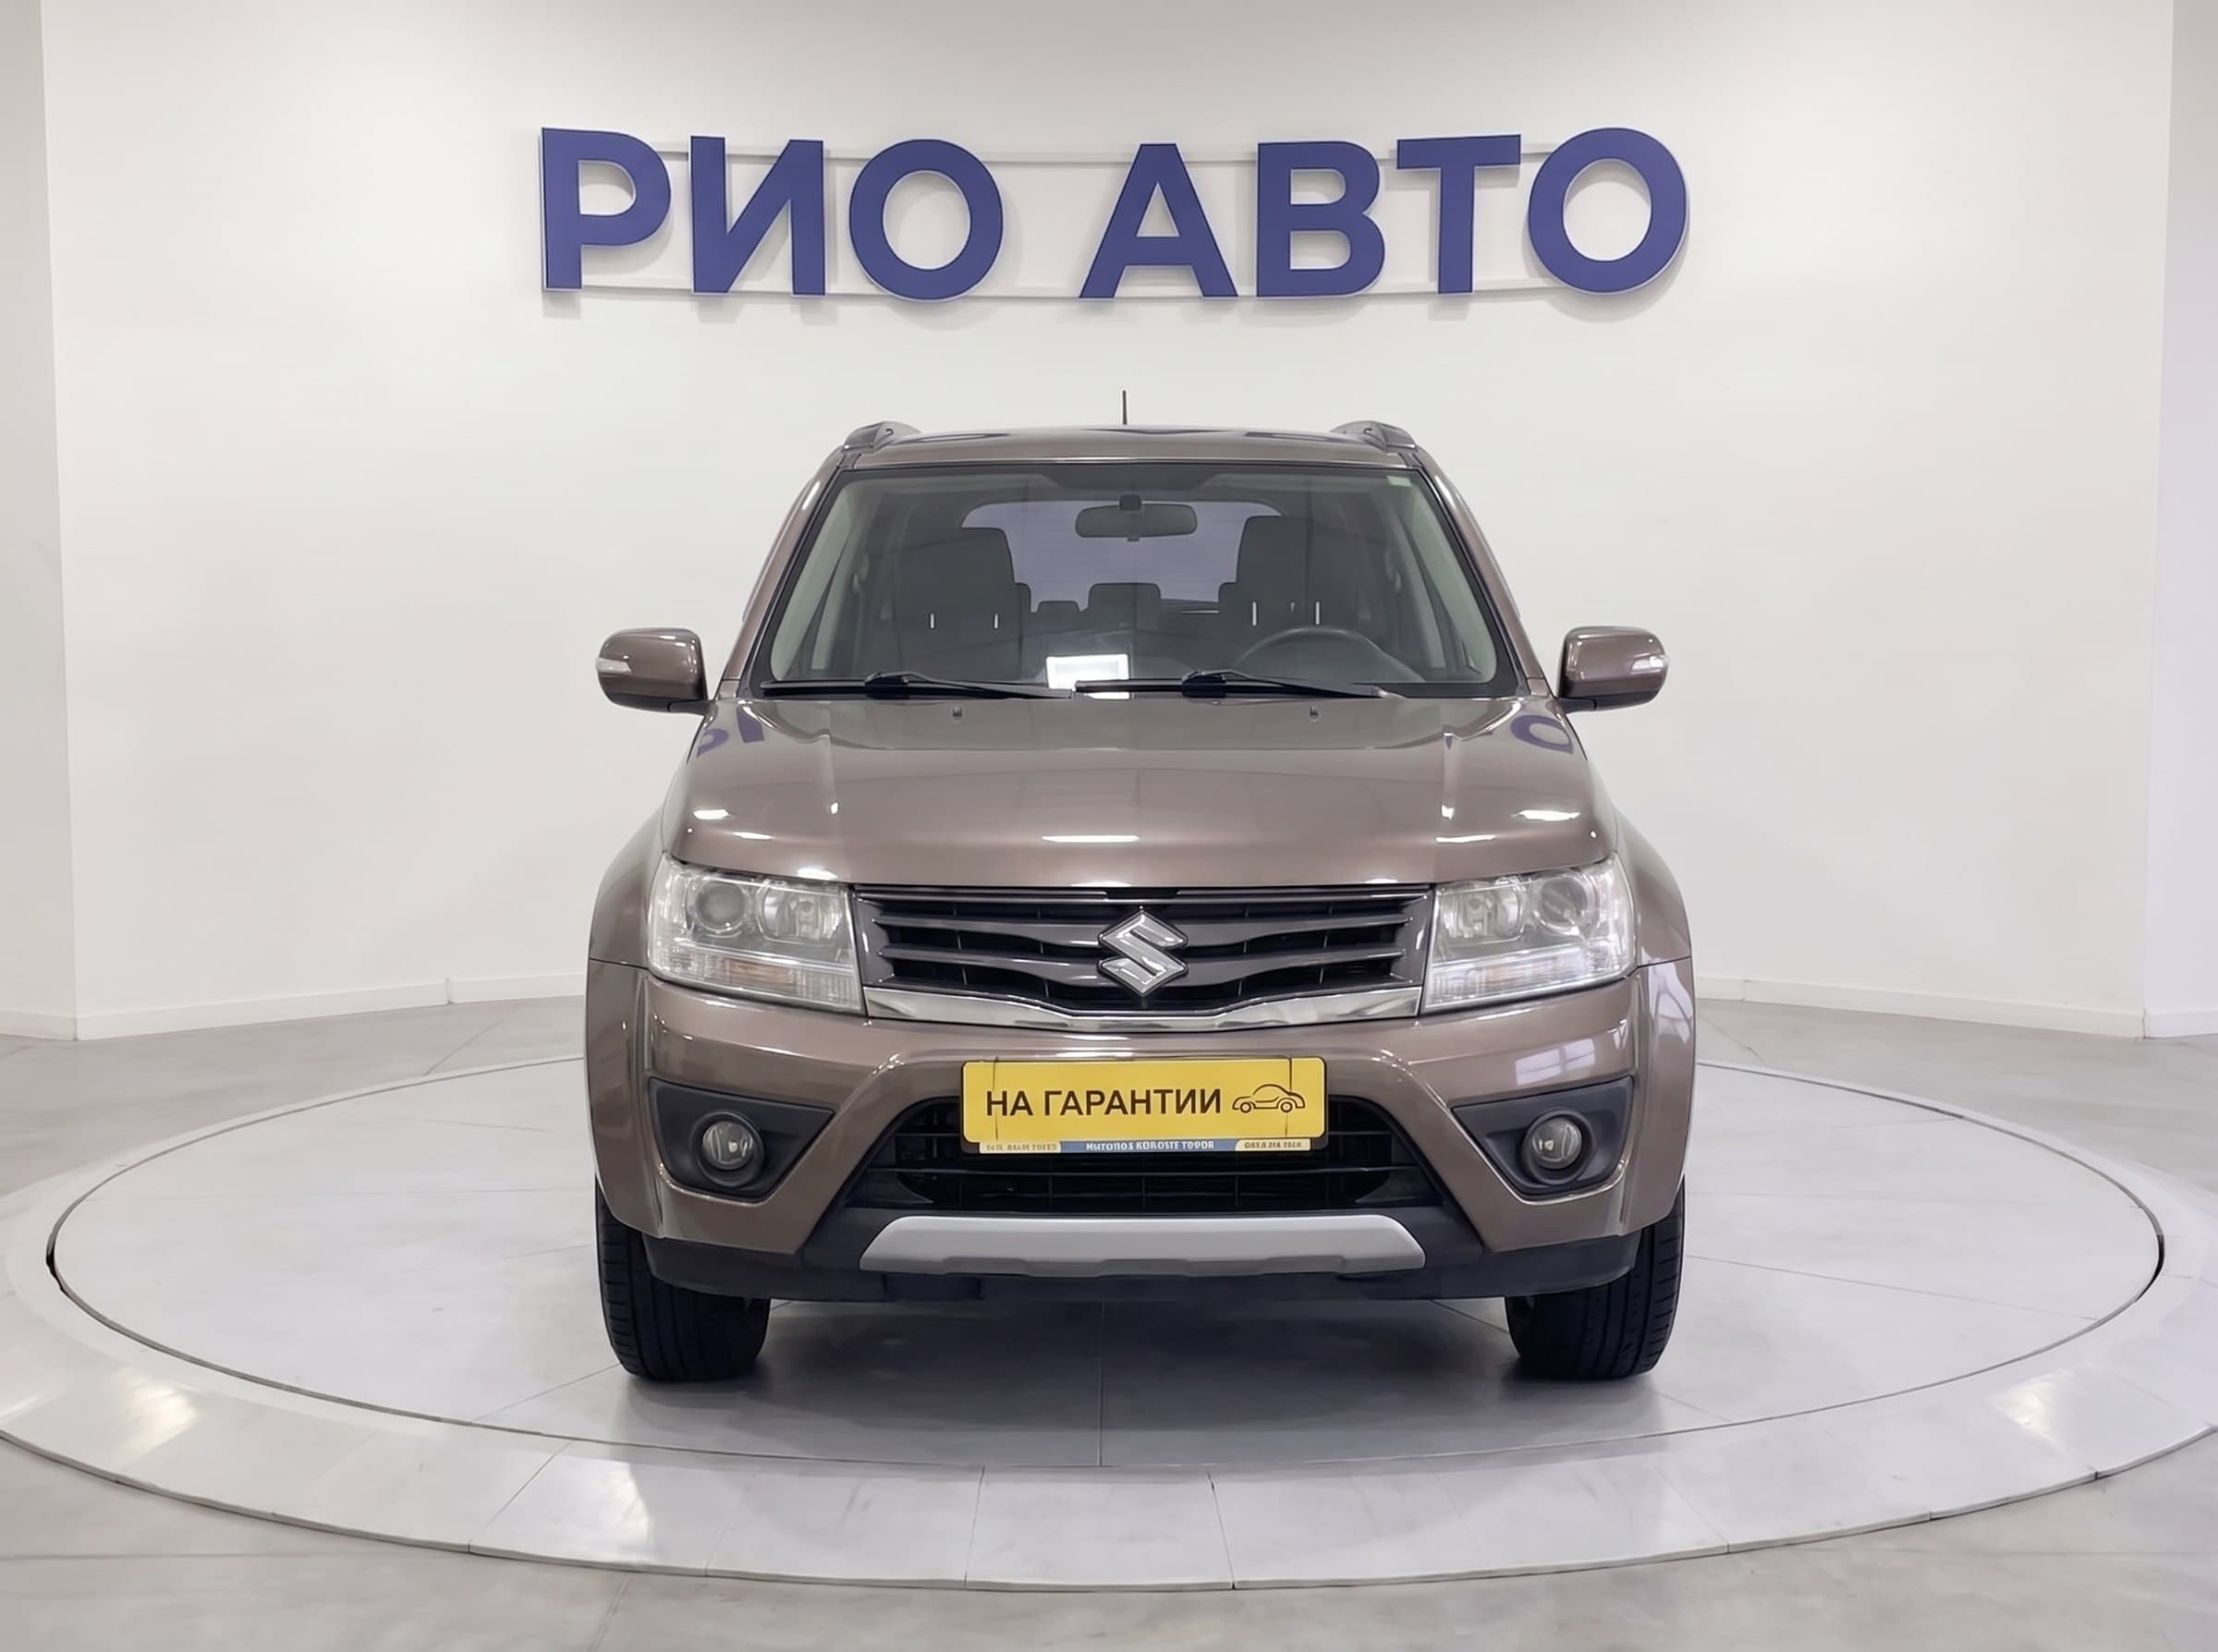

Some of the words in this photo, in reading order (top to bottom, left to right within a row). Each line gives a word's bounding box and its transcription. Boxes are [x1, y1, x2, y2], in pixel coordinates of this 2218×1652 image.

[540, 128, 1003, 300] РИО
[1079, 128, 1689, 299] АВТО
[986, 1090, 1033, 1117] НА
[1044, 1088, 1222, 1116] ГАРАНТИИ
